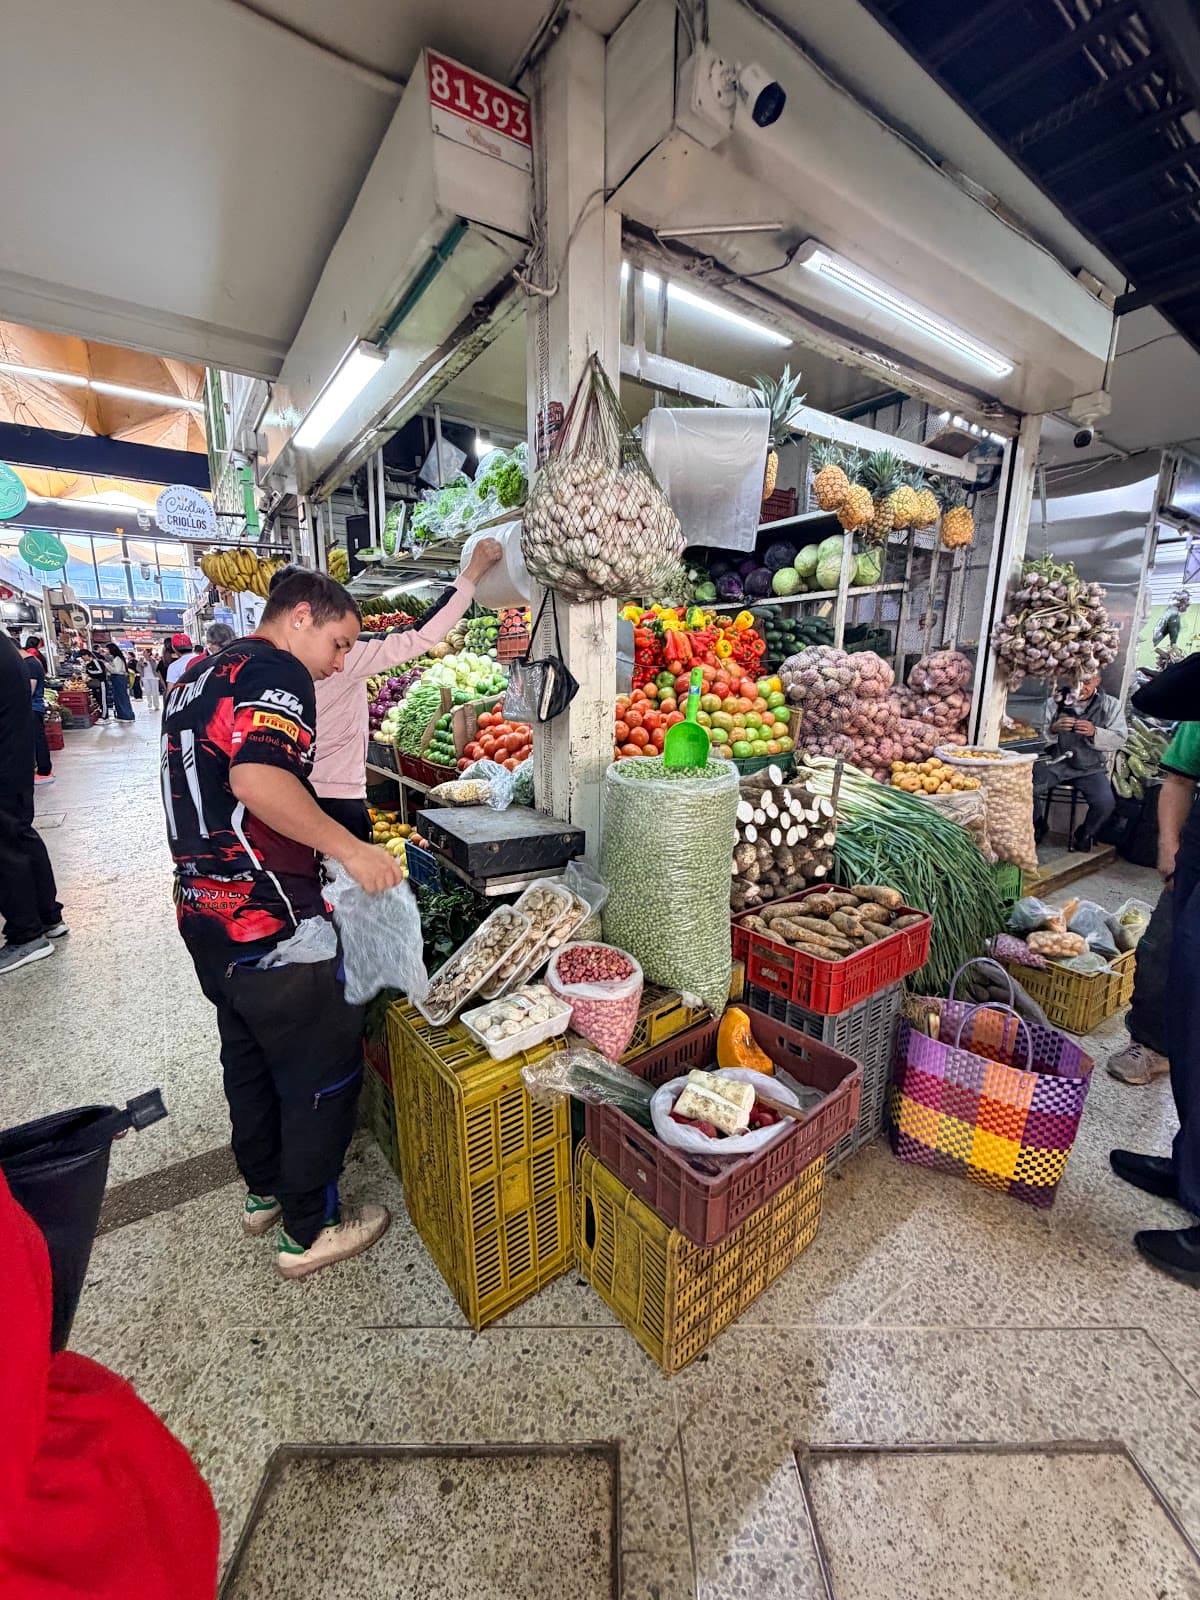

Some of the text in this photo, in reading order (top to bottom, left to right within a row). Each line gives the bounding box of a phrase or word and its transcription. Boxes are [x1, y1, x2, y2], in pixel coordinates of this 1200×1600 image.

[431, 63, 528, 138] 81393
[167, 515, 207, 530] CRIOLLOS
[260, 688, 304, 716] KTM
